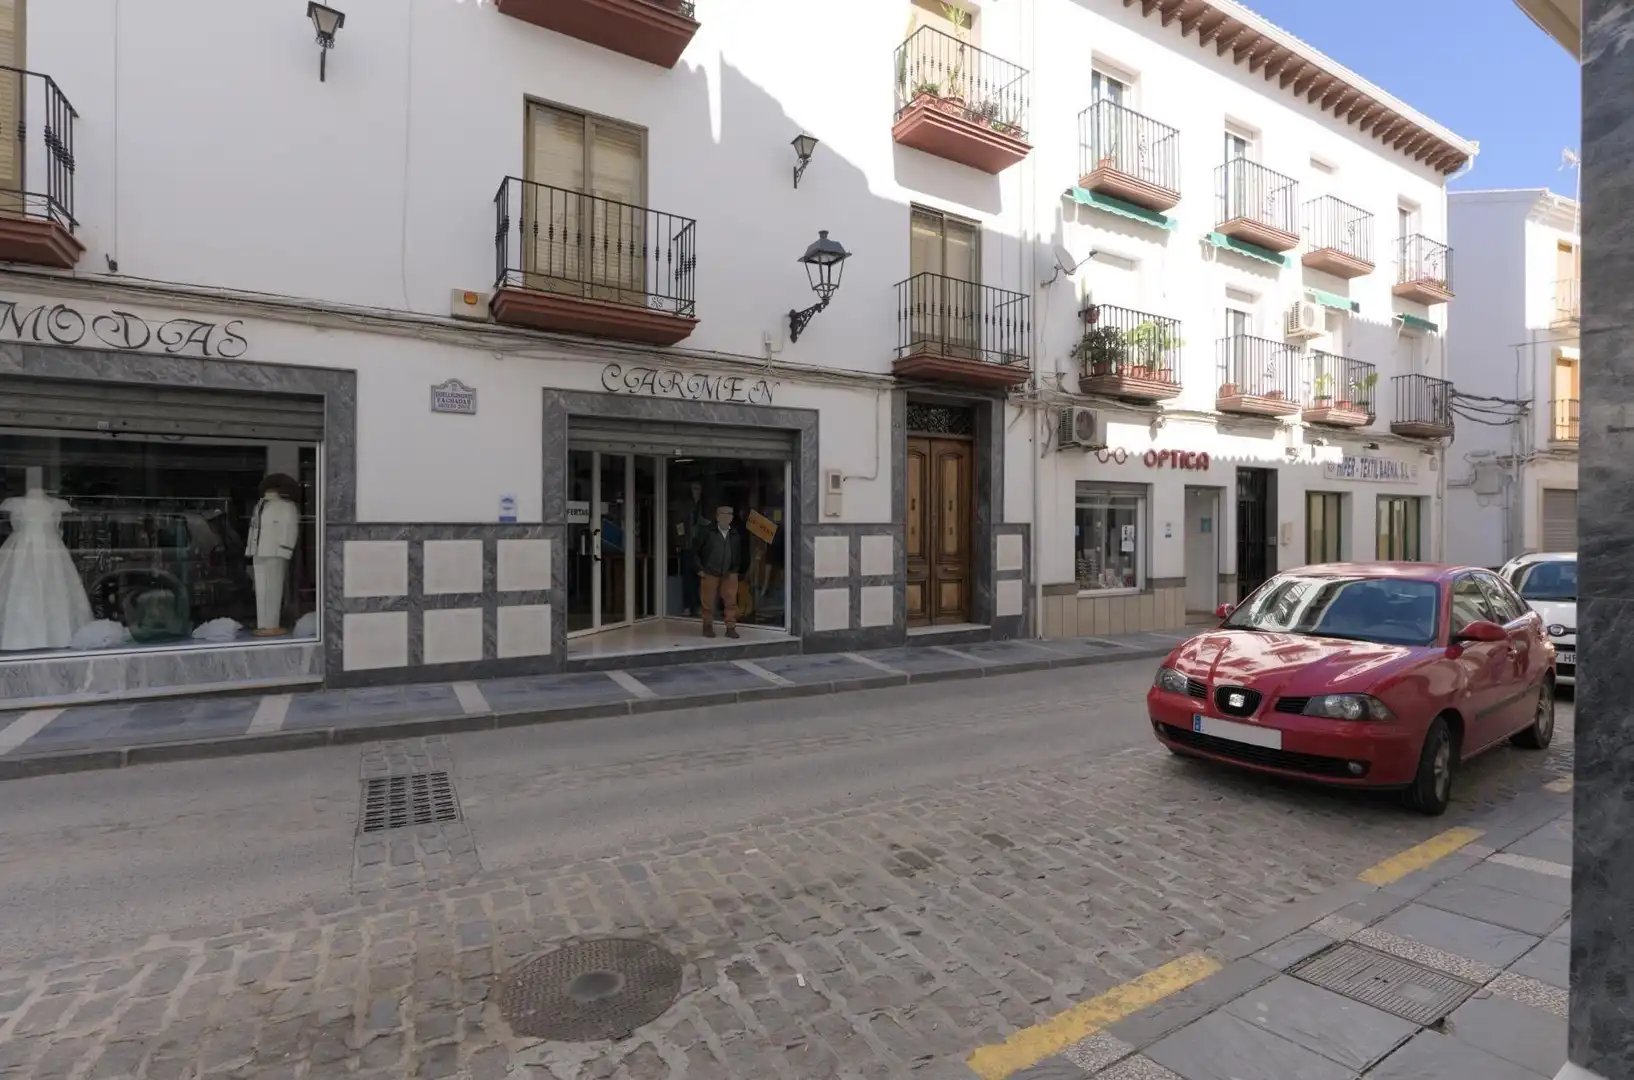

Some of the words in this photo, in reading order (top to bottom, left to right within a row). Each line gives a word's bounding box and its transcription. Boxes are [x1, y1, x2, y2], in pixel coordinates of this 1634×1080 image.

[0, 301, 248, 358] MODAS
[601, 363, 781, 404] CARMEN
[1143, 448, 1210, 472] OPTICA
